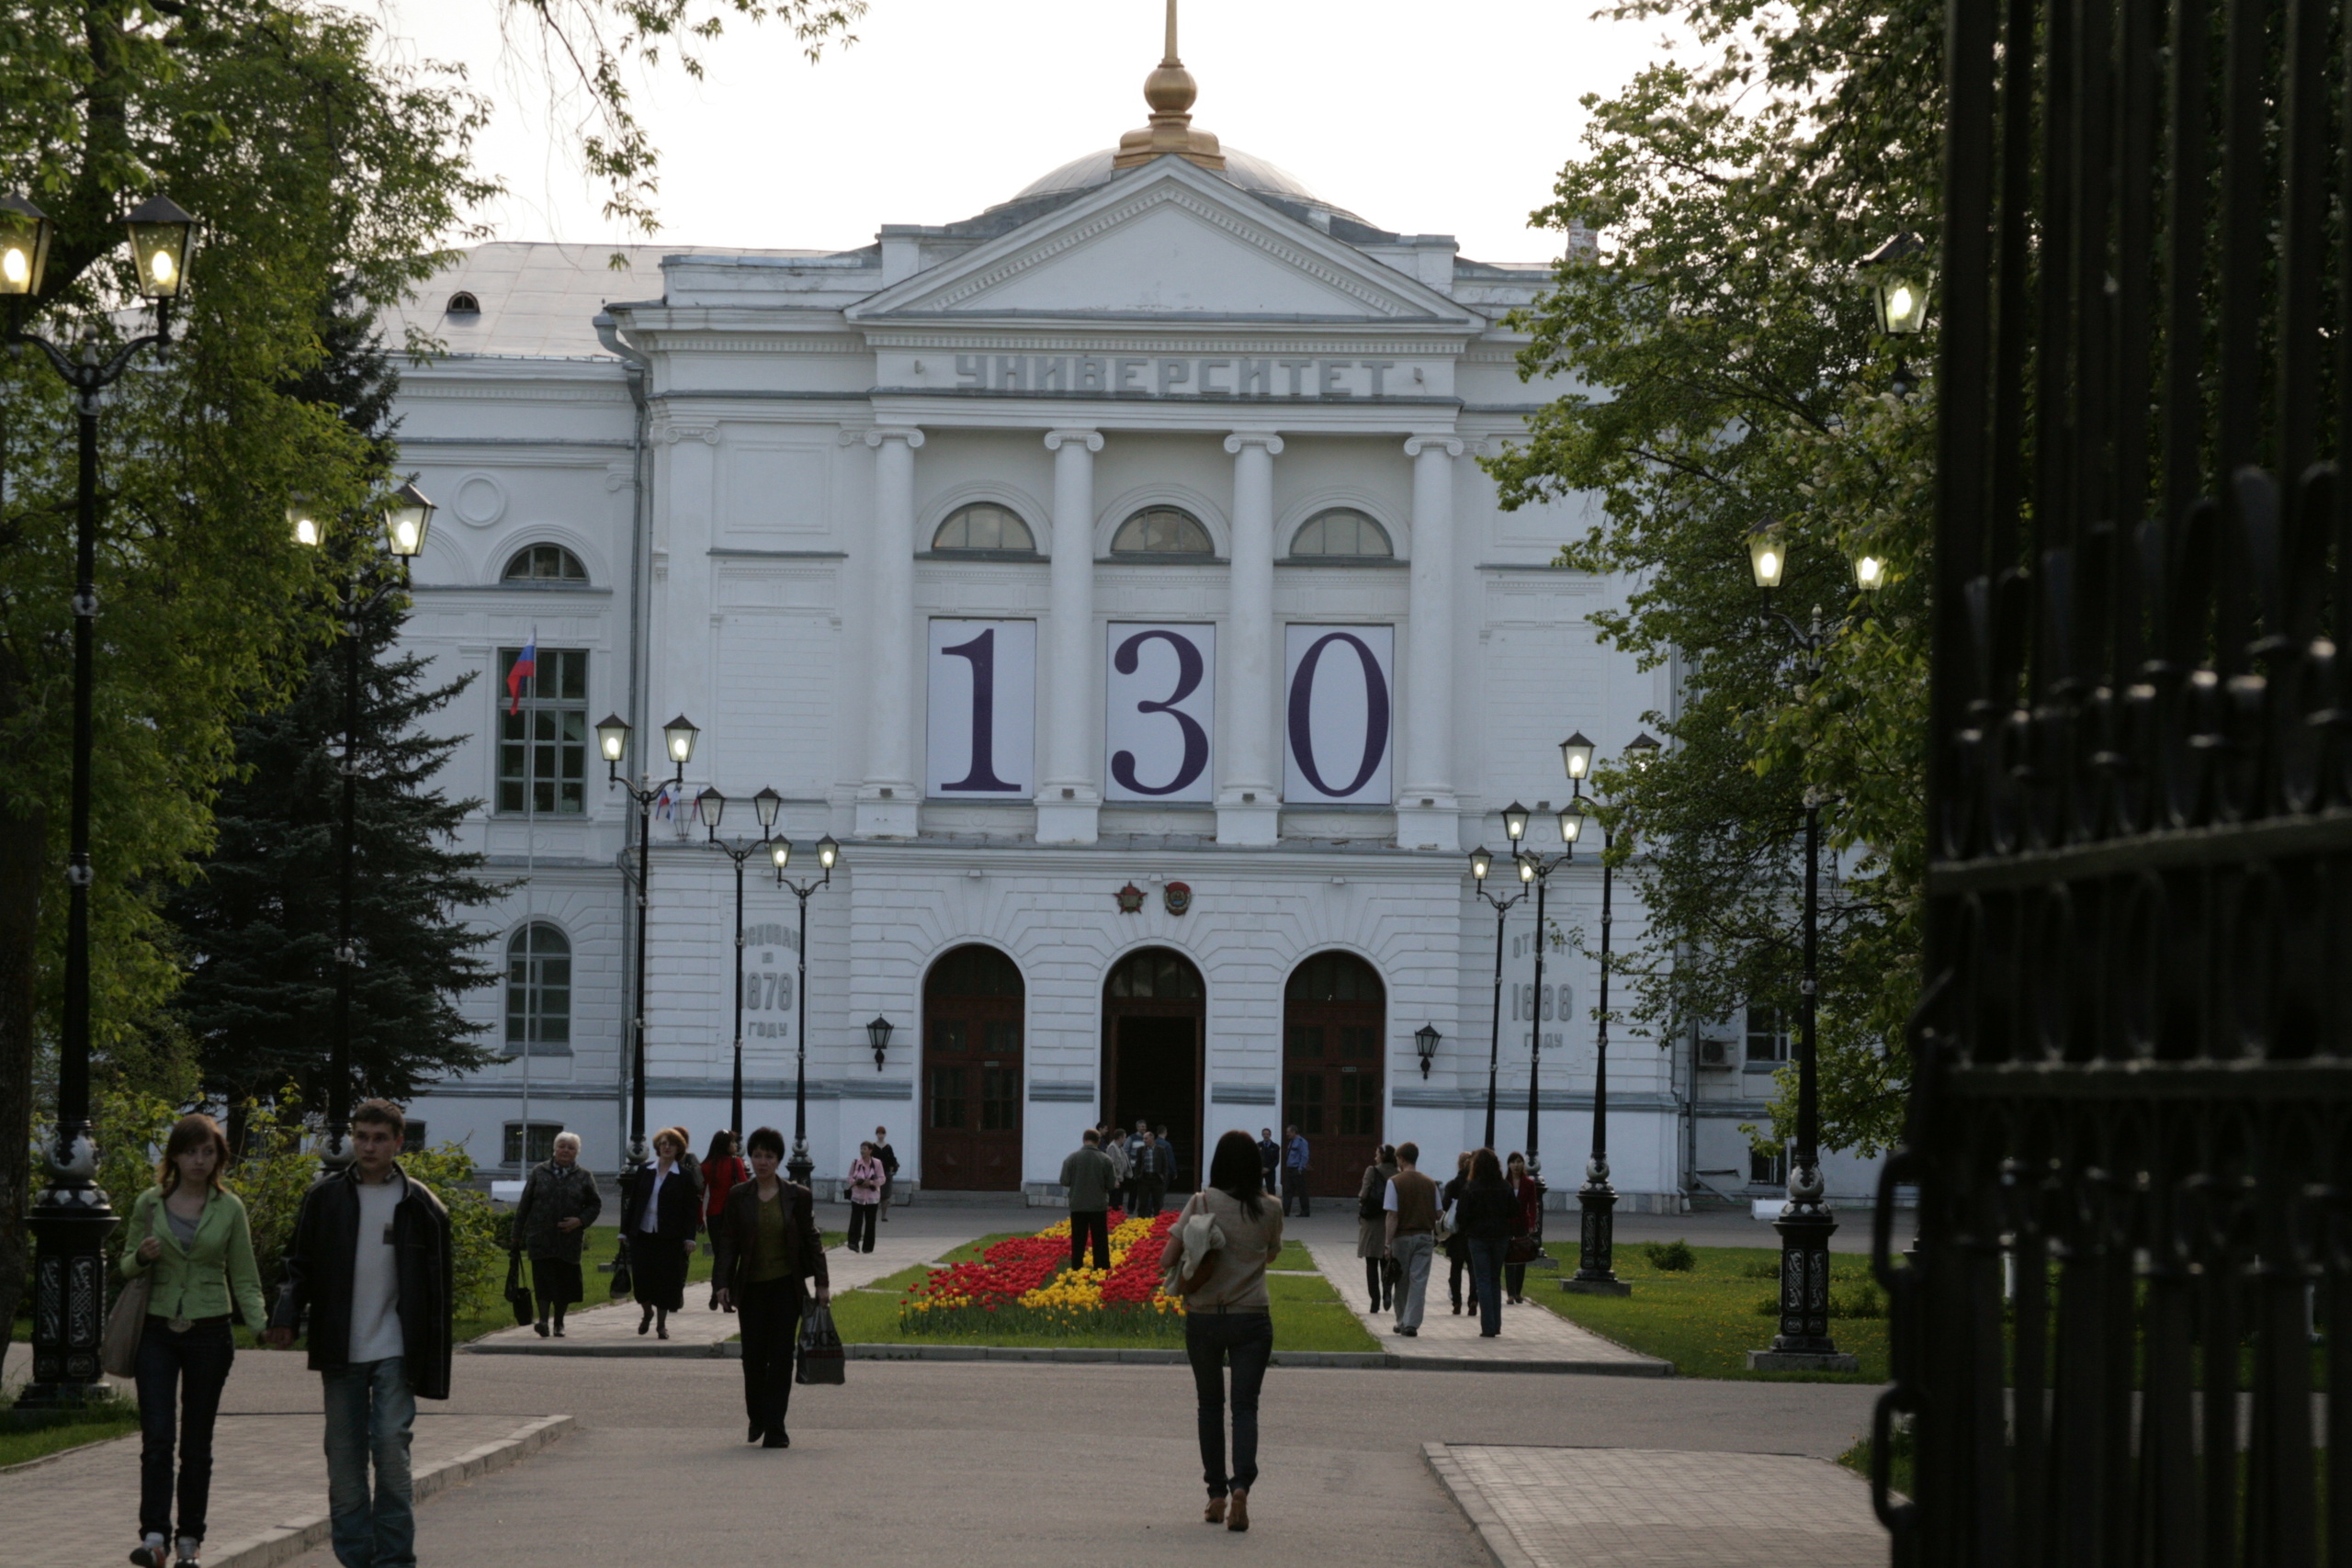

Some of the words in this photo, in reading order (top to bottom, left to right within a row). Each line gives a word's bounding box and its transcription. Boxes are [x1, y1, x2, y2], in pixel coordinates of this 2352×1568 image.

[956, 355, 1395, 396] УНИВЕРСИТЕТ
[1513, 983, 1572, 1021] 1888
[748, 1021, 787, 1038] ГОДУ
